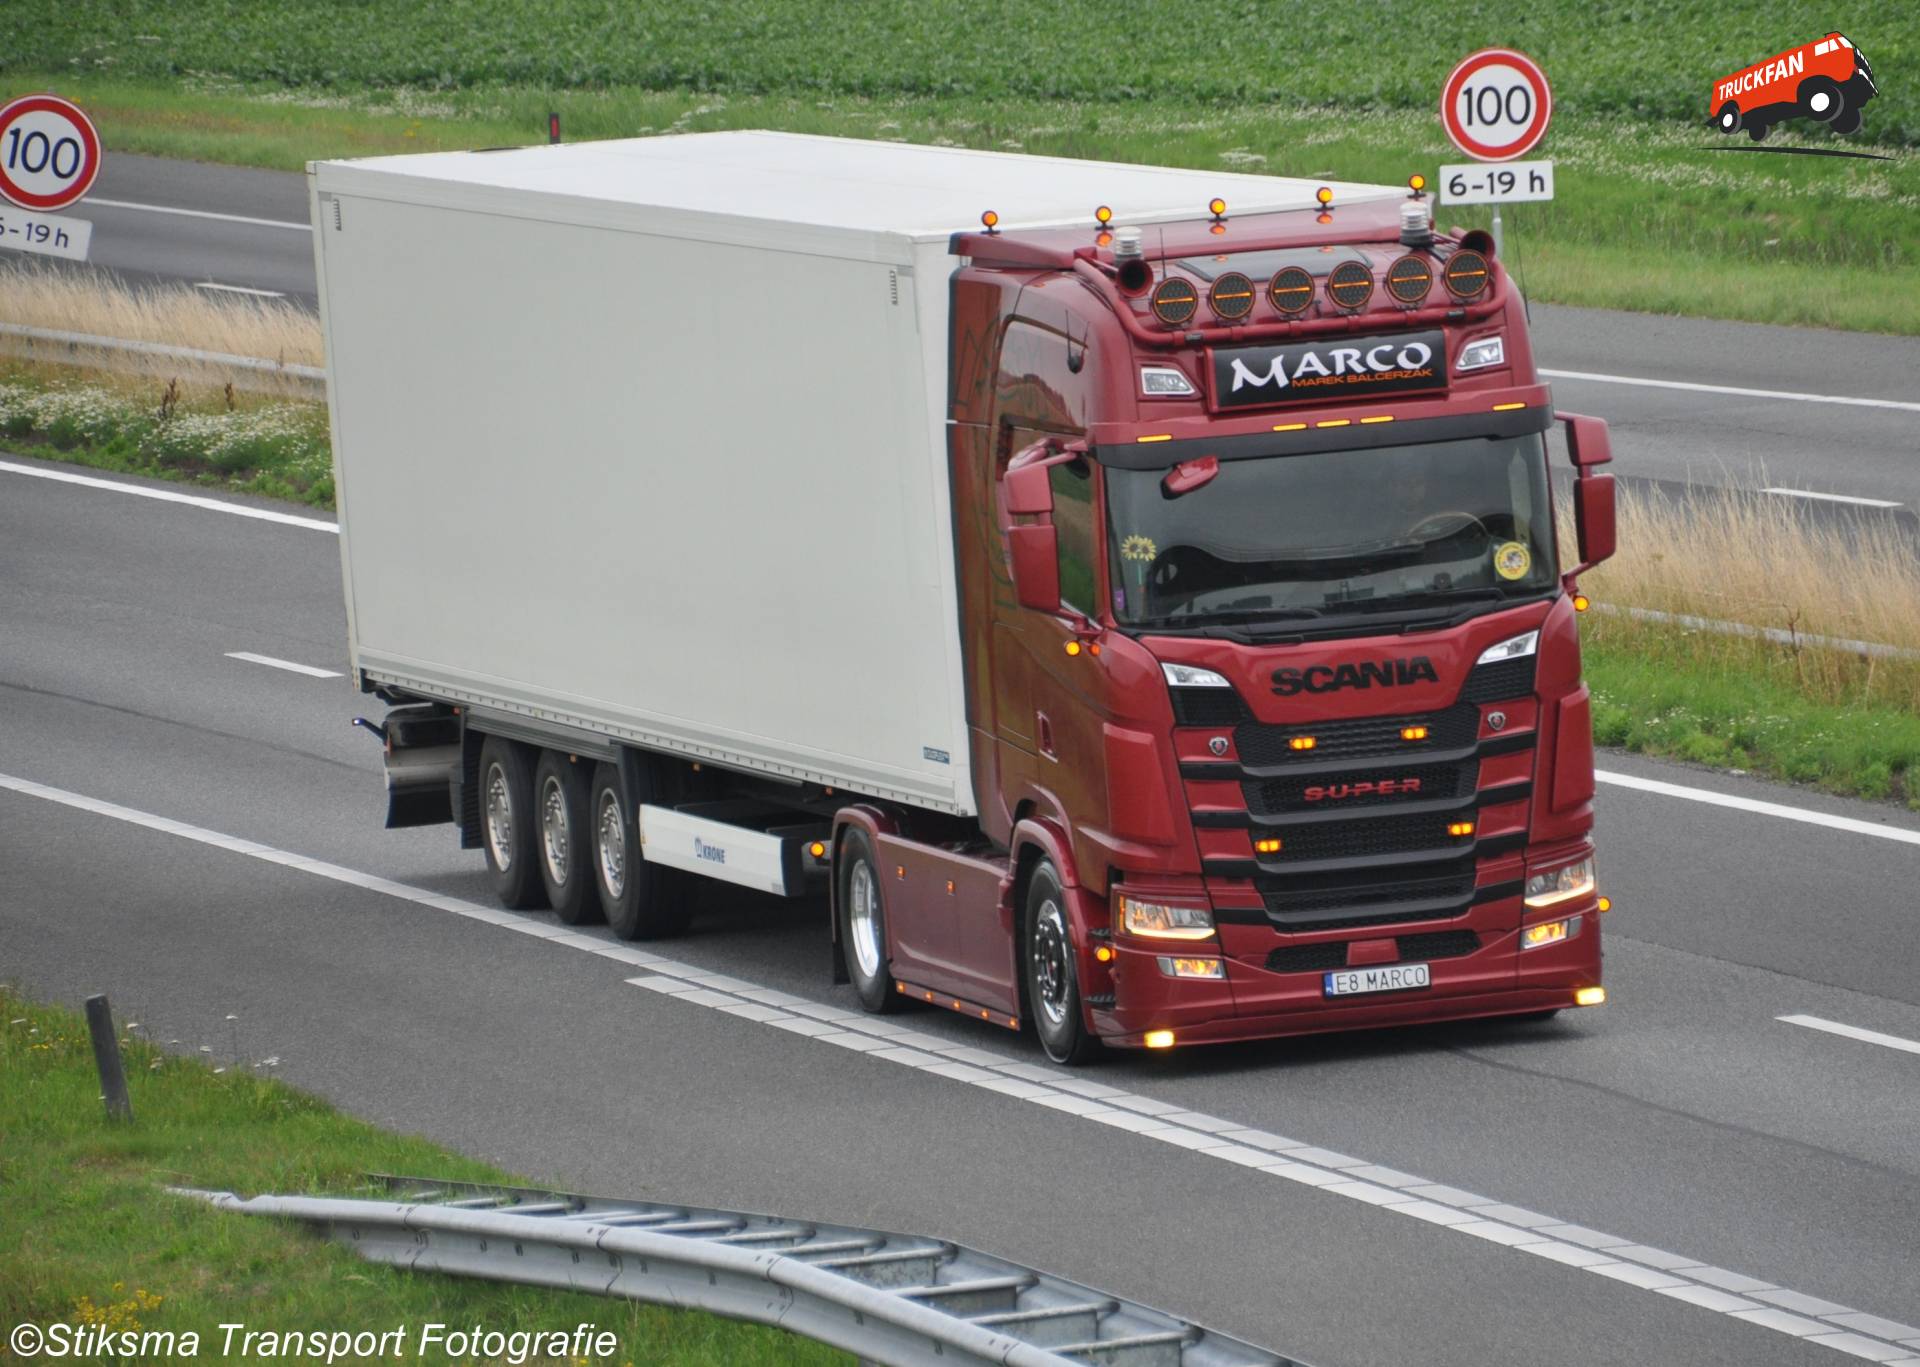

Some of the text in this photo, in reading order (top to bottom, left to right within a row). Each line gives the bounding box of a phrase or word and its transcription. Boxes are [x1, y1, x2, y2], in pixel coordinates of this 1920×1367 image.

[1463, 85, 1531, 126] 100
[8, 127, 80, 179] 100
[1449, 169, 1545, 196] 6-19 h
[54, 227, 69, 248] h
[1230, 342, 1432, 393] MARCO
[1292, 368, 1433, 388] MAREK BALCERZAK
[1270, 656, 1439, 697] SCANIA
[1304, 778, 1421, 801] SUPER
[703, 844, 726, 864] KRONE
[1336, 967, 1426, 993] E8 MARCO
